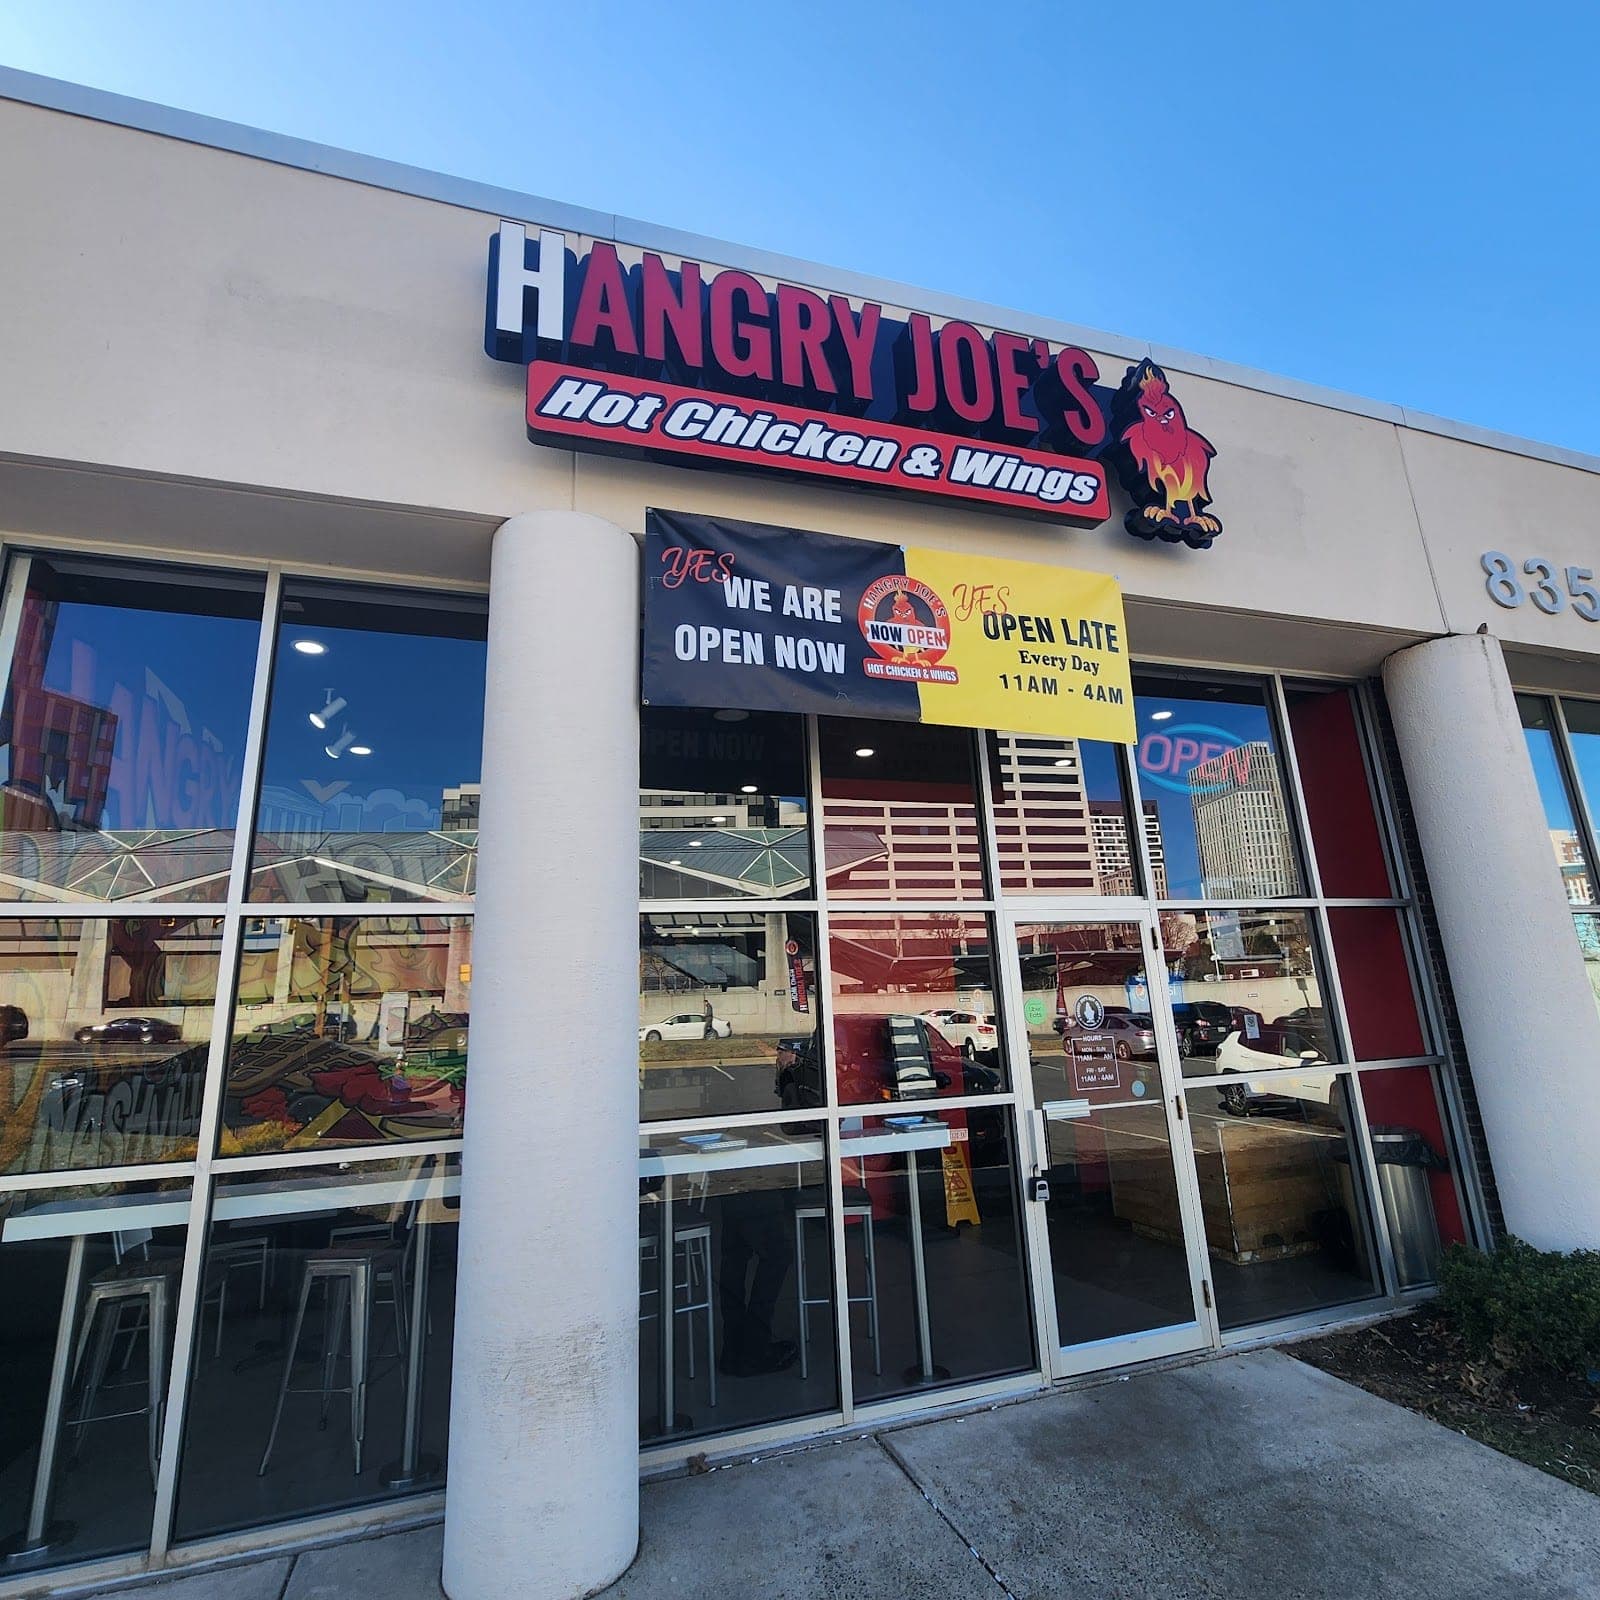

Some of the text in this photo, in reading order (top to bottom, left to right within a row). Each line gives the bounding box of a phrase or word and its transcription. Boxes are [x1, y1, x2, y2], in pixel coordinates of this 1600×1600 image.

[495, 219, 1107, 446] HANGRY JOE'S
[540, 378, 1098, 502] Hot Chicken & Wings
[661, 546, 735, 589] YES
[1480, 550, 1600, 622] 835
[721, 573, 842, 624] WE ARE
[863, 578, 947, 618] HANGRY JOE'S
[952, 583, 1010, 622] YES
[674, 623, 846, 674] OPEN NOW
[870, 623, 946, 648] NOW OPEN
[983, 610, 1120, 653] OPEN LATE
[867, 663, 957, 682] HOT CHICKEN & WINGS
[1018, 650, 1100, 676] Every Day
[999, 673, 1058, 696] 11AM
[1083, 683, 1124, 705] 4AM
[1138, 733, 1252, 786] OPEN
[1082, 1034, 1102, 1042] HOURS
